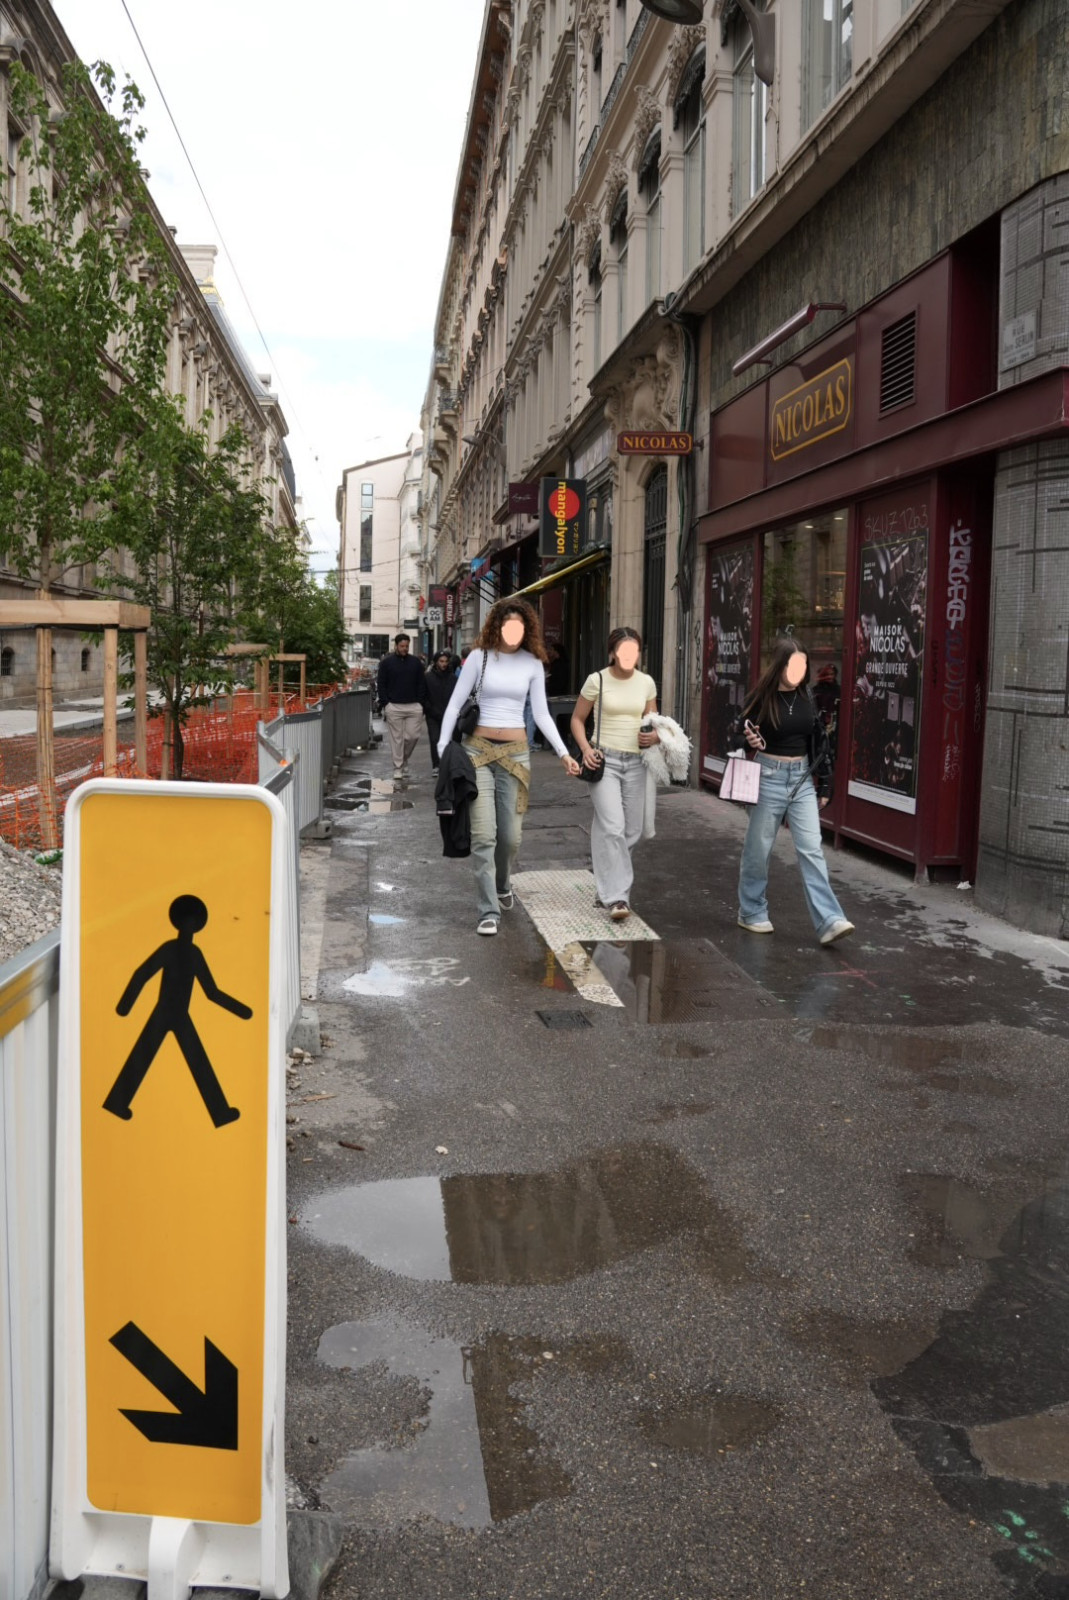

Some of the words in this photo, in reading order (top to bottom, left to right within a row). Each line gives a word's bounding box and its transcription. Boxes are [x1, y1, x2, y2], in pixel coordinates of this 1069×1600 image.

[774, 375, 846, 448] NICOLAS
[623, 436, 687, 449] NICOLAS
[554, 481, 569, 555] mangalyon
[446, 594, 454, 623] CINEMA
[874, 624, 902, 637] MAISON
[717, 641, 740, 656] NICOLAS
[870, 636, 906, 653] NICOLAS
[865, 662, 885, 674] GRANDE
